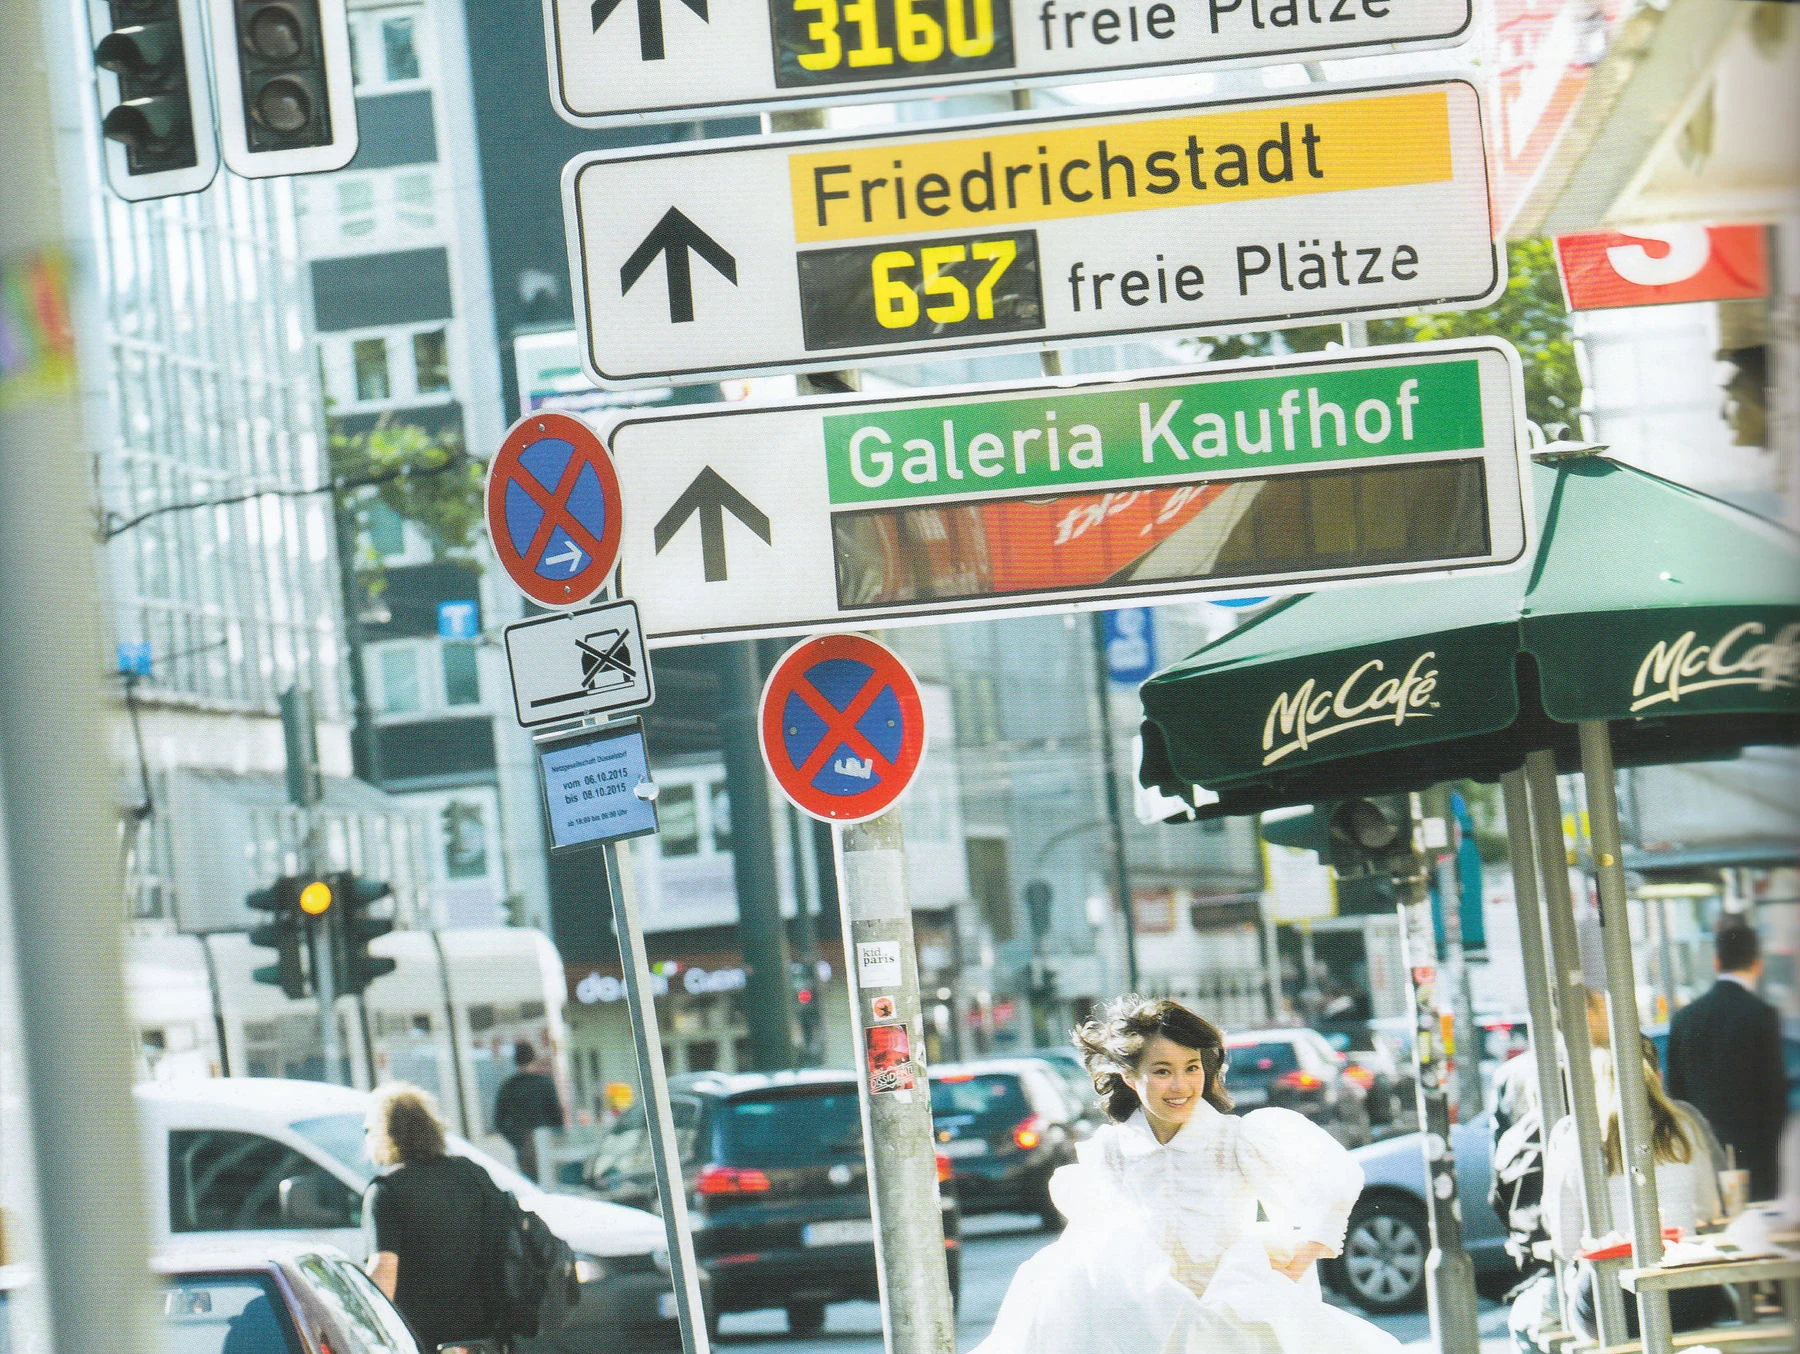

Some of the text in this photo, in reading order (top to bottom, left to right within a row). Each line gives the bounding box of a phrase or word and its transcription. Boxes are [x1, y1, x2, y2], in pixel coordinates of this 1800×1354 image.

[797, 0, 996, 71] 3160
[1040, 0, 1176, 50] freie
[813, 121, 1324, 226] Friedrichstadt
[871, 239, 1018, 329] 657
[1068, 239, 1419, 312] freie Plätze
[848, 378, 1420, 488] Galeria Kaufhof
[1263, 652, 1438, 766] McCafé
[563, 767, 628, 790] vom 06.10.2015
[565, 782, 627, 804] bis 08.10.2015
[863, 947, 881, 957] kid
[863, 954, 895, 967] paris
